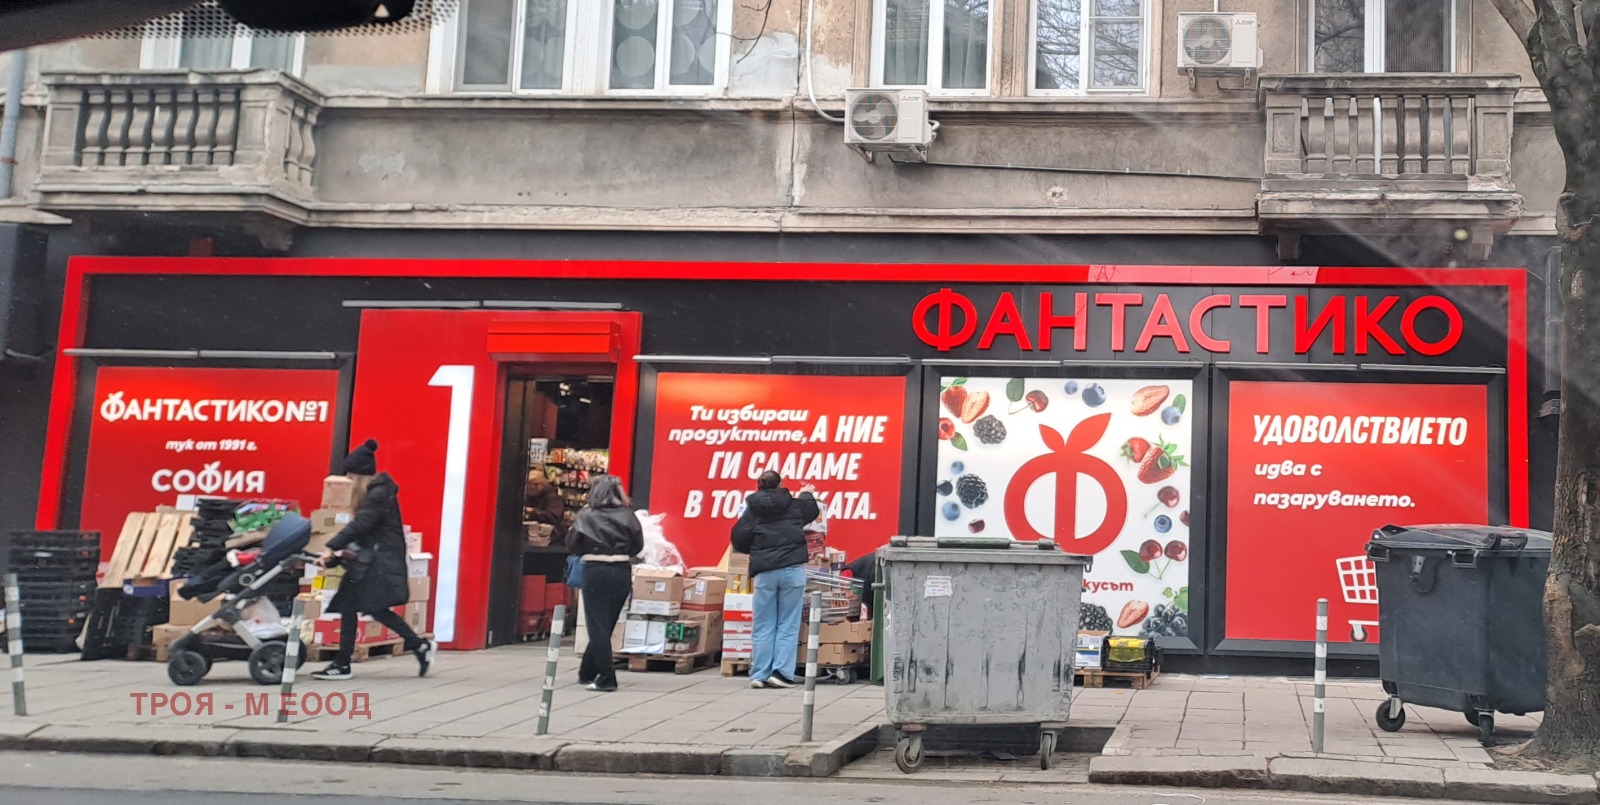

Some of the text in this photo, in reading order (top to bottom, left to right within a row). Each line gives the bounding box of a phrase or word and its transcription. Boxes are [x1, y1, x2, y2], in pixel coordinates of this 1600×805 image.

[911, 287, 1463, 356] ФАНТАСТИКО
[690, 404, 808, 424] Ти избираш
[668, 415, 888, 445] продуктите, А НИЕ
[1252, 414, 1468, 446] УДОВОЛСТВИЕТО
[165, 438, 194, 453] тук
[195, 441, 218, 451] от
[219, 439, 246, 451] 1991
[151, 461, 265, 494] СОФИЯ
[707, 450, 863, 481] ГИ СЛАГАМЕ
[1254, 459, 1323, 480] идва с
[683, 489, 704, 518] В
[1253, 489, 1416, 510] пазаруването.
[1082, 579, 1134, 594] кусът
